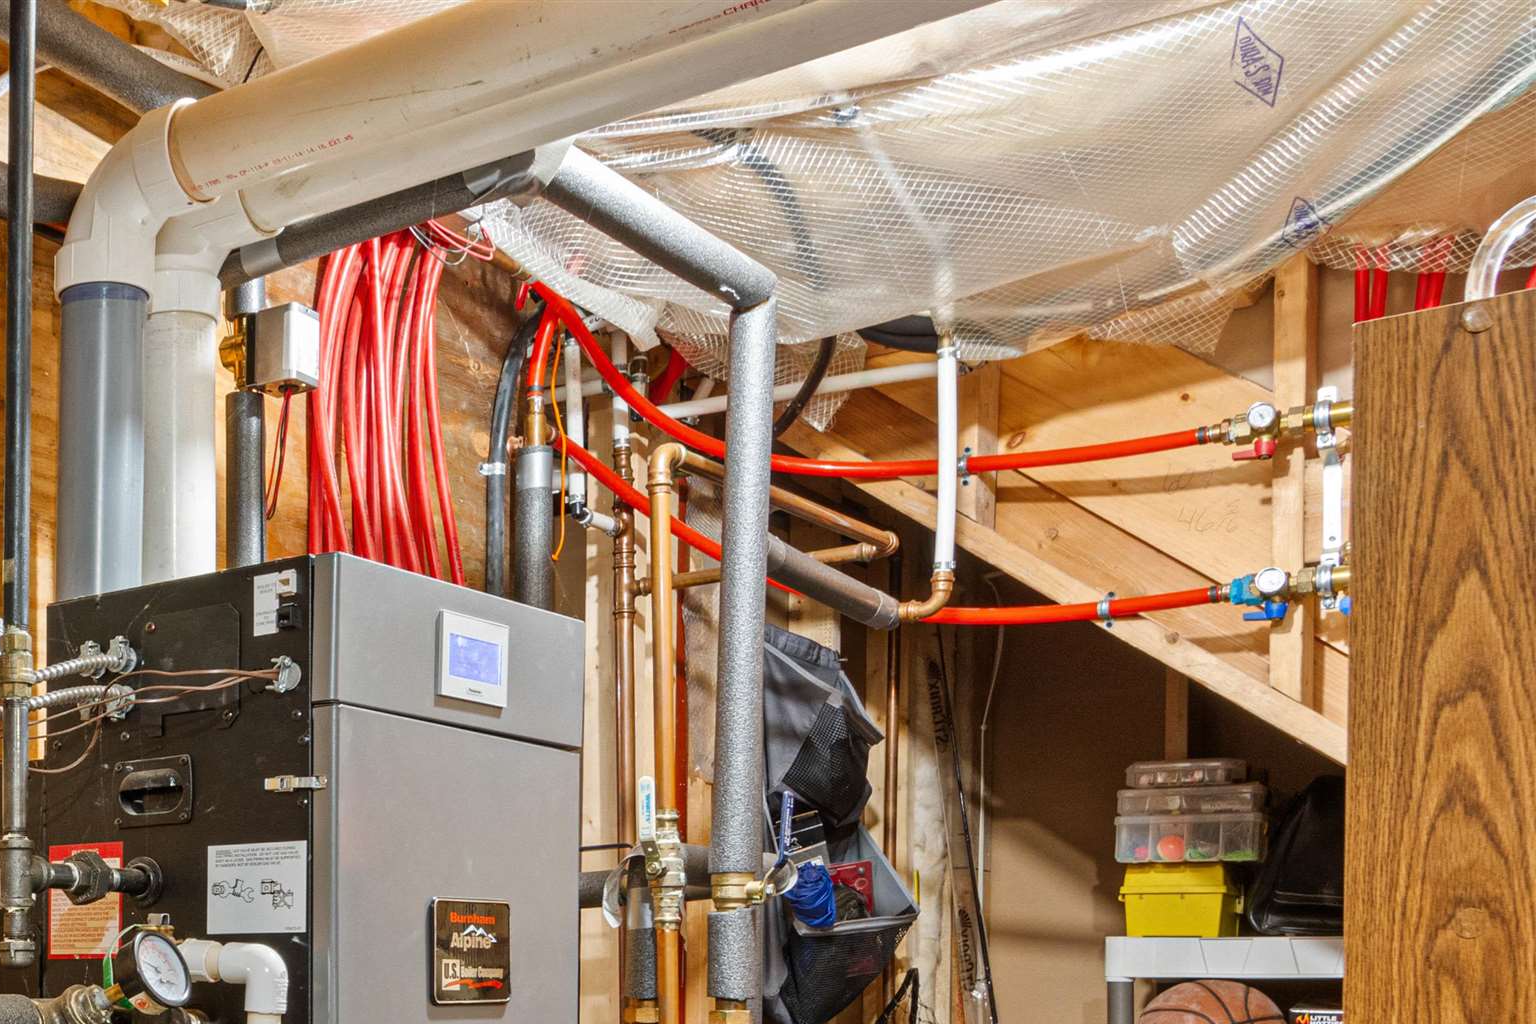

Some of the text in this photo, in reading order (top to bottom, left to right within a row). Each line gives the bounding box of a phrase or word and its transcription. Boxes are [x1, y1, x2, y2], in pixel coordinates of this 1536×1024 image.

[450, 912, 496, 925] Burnham
[450, 932, 492, 952] Alpine
[443, 962, 459, 979] U.S.
